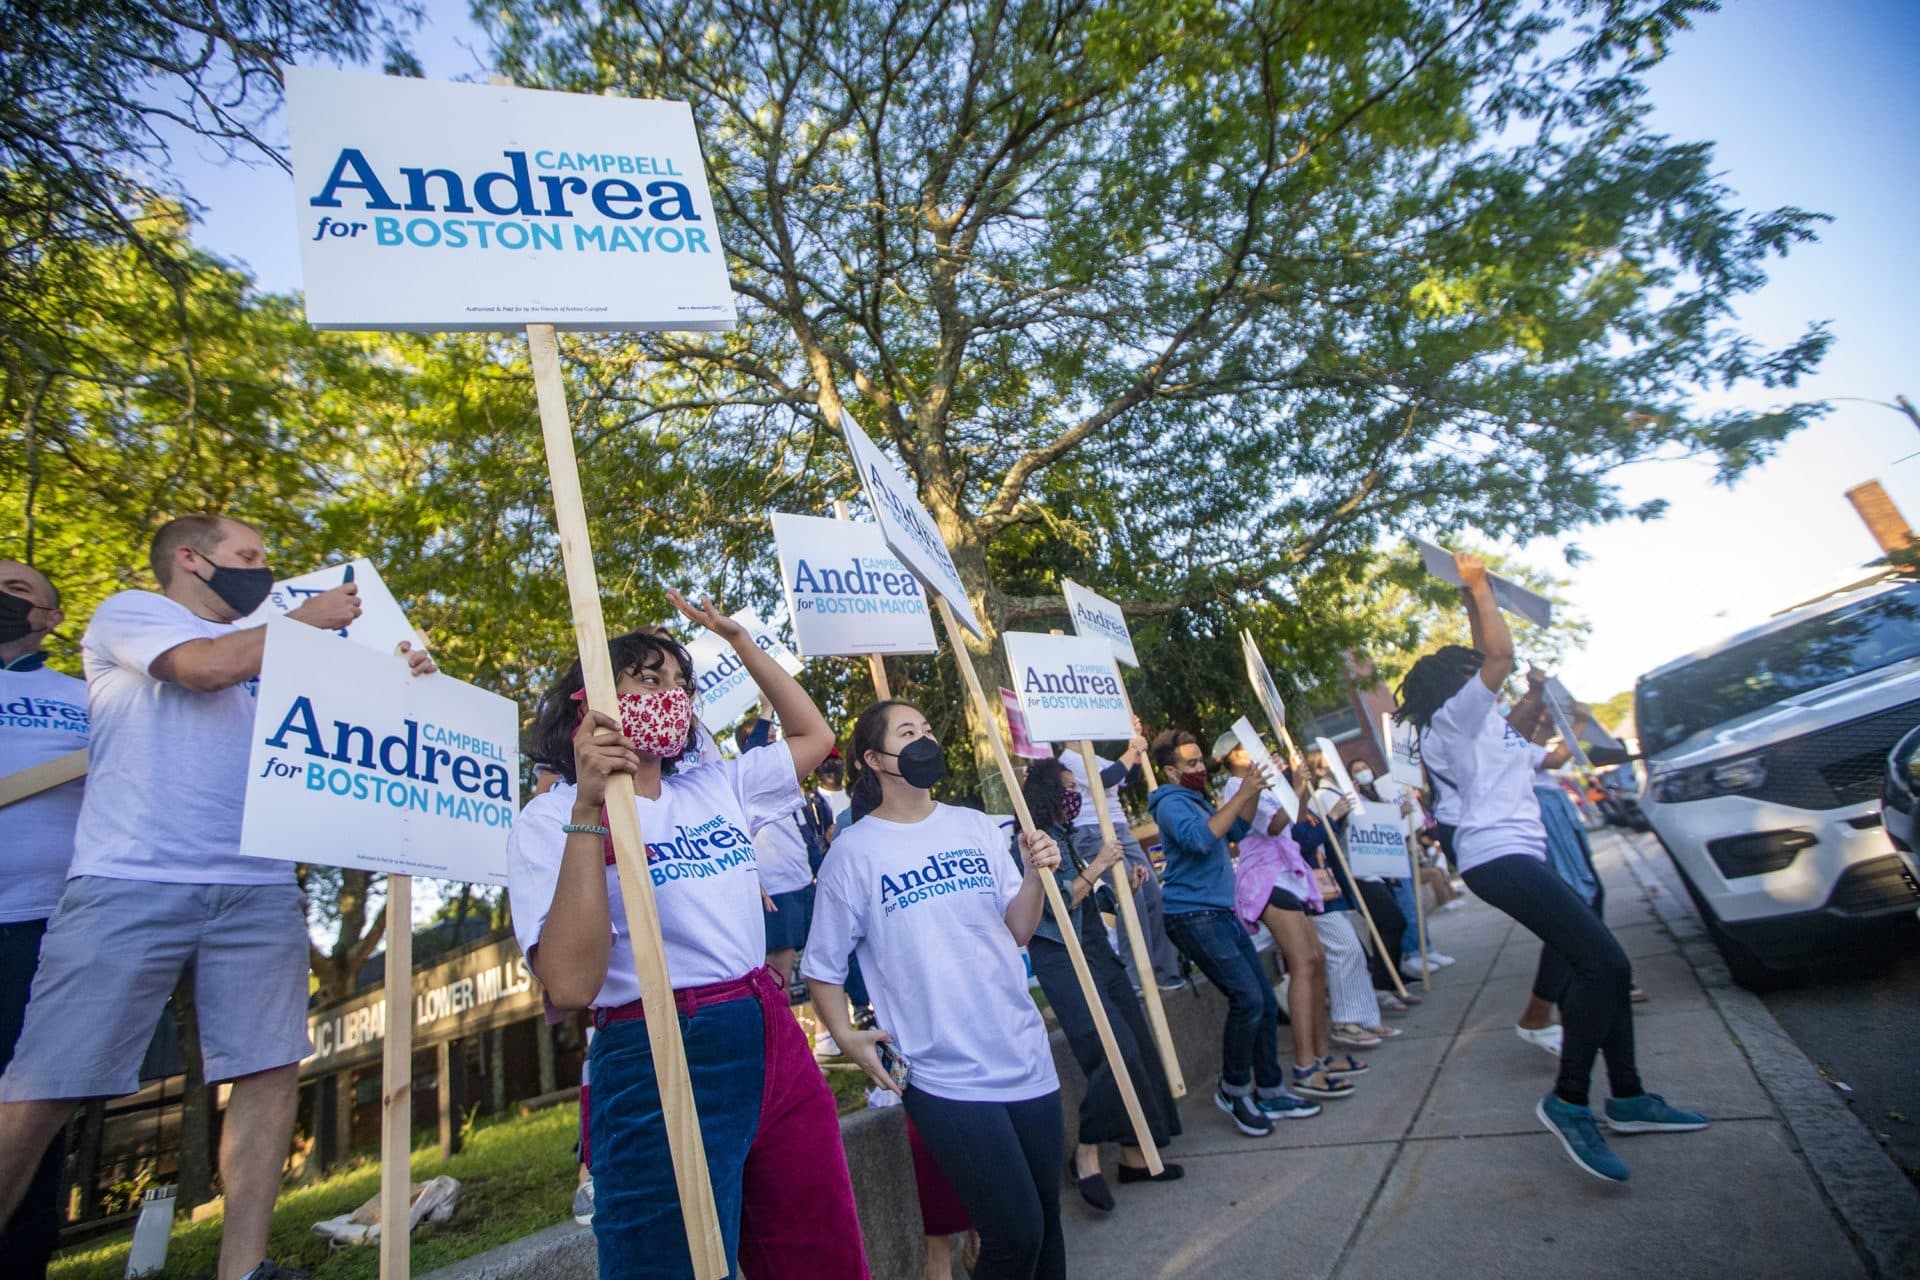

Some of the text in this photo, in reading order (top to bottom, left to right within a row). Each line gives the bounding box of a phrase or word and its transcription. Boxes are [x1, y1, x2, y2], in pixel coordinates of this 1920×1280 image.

[535, 151, 682, 176] CAMPBELL
[310, 147, 702, 221] Andrea
[312, 216, 710, 253] for BOSTON MAYOR
[793, 558, 920, 596] Andrea
[862, 557, 906, 571] CAMPBE
[797, 597, 925, 615] for BOSTON MAYOR
[1077, 601, 1128, 639] Andrea
[1024, 664, 1120, 695] Andrea
[0, 696, 90, 725] dre
[1028, 696, 1124, 709] for BOSTON MAYOR
[0, 716, 48, 729] TON
[265, 695, 512, 802] Andrea
[422, 723, 507, 762] CAMPBELL
[261, 757, 513, 830] for BOSTON MAYOR
[645, 825, 752, 866] ndrea
[1349, 823, 1403, 846] Andrea
[649, 846, 756, 887] BOSTON MAYO
[938, 848, 984, 861] CAMPBELL
[880, 855, 991, 904] Andrea
[885, 902, 897, 917] for
[897, 879, 956, 909] BOSTON
[334, 999, 386, 1053] LIBRA
[417, 977, 474, 1025] LOWER
[477, 956, 531, 1006] MILLS
